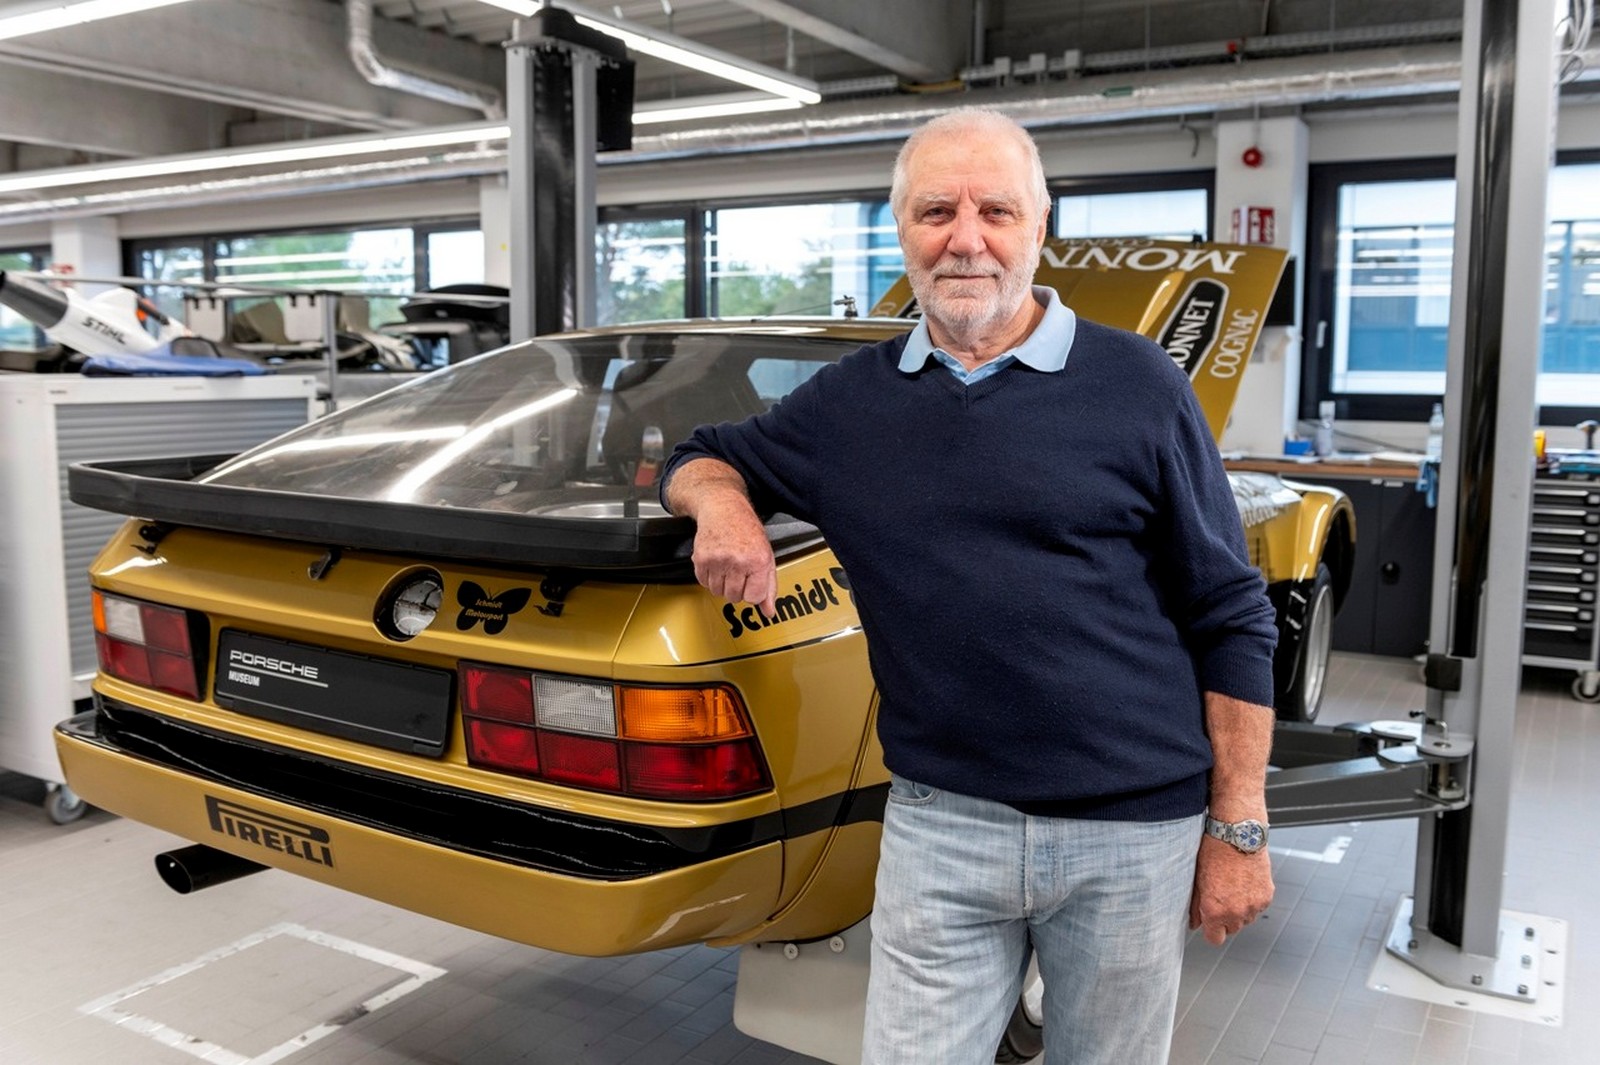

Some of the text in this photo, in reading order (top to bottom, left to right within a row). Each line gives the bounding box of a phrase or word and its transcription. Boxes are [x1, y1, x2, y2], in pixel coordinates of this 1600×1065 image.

[81, 316, 126, 345] STIHL
[1166, 297, 1214, 369] ONNET
[1210, 309, 1258, 378] COGNAC
[228, 670, 260, 687] MUSEUM
[230, 650, 319, 679] PORSCHE
[204, 794, 333, 868] PIRELLI
